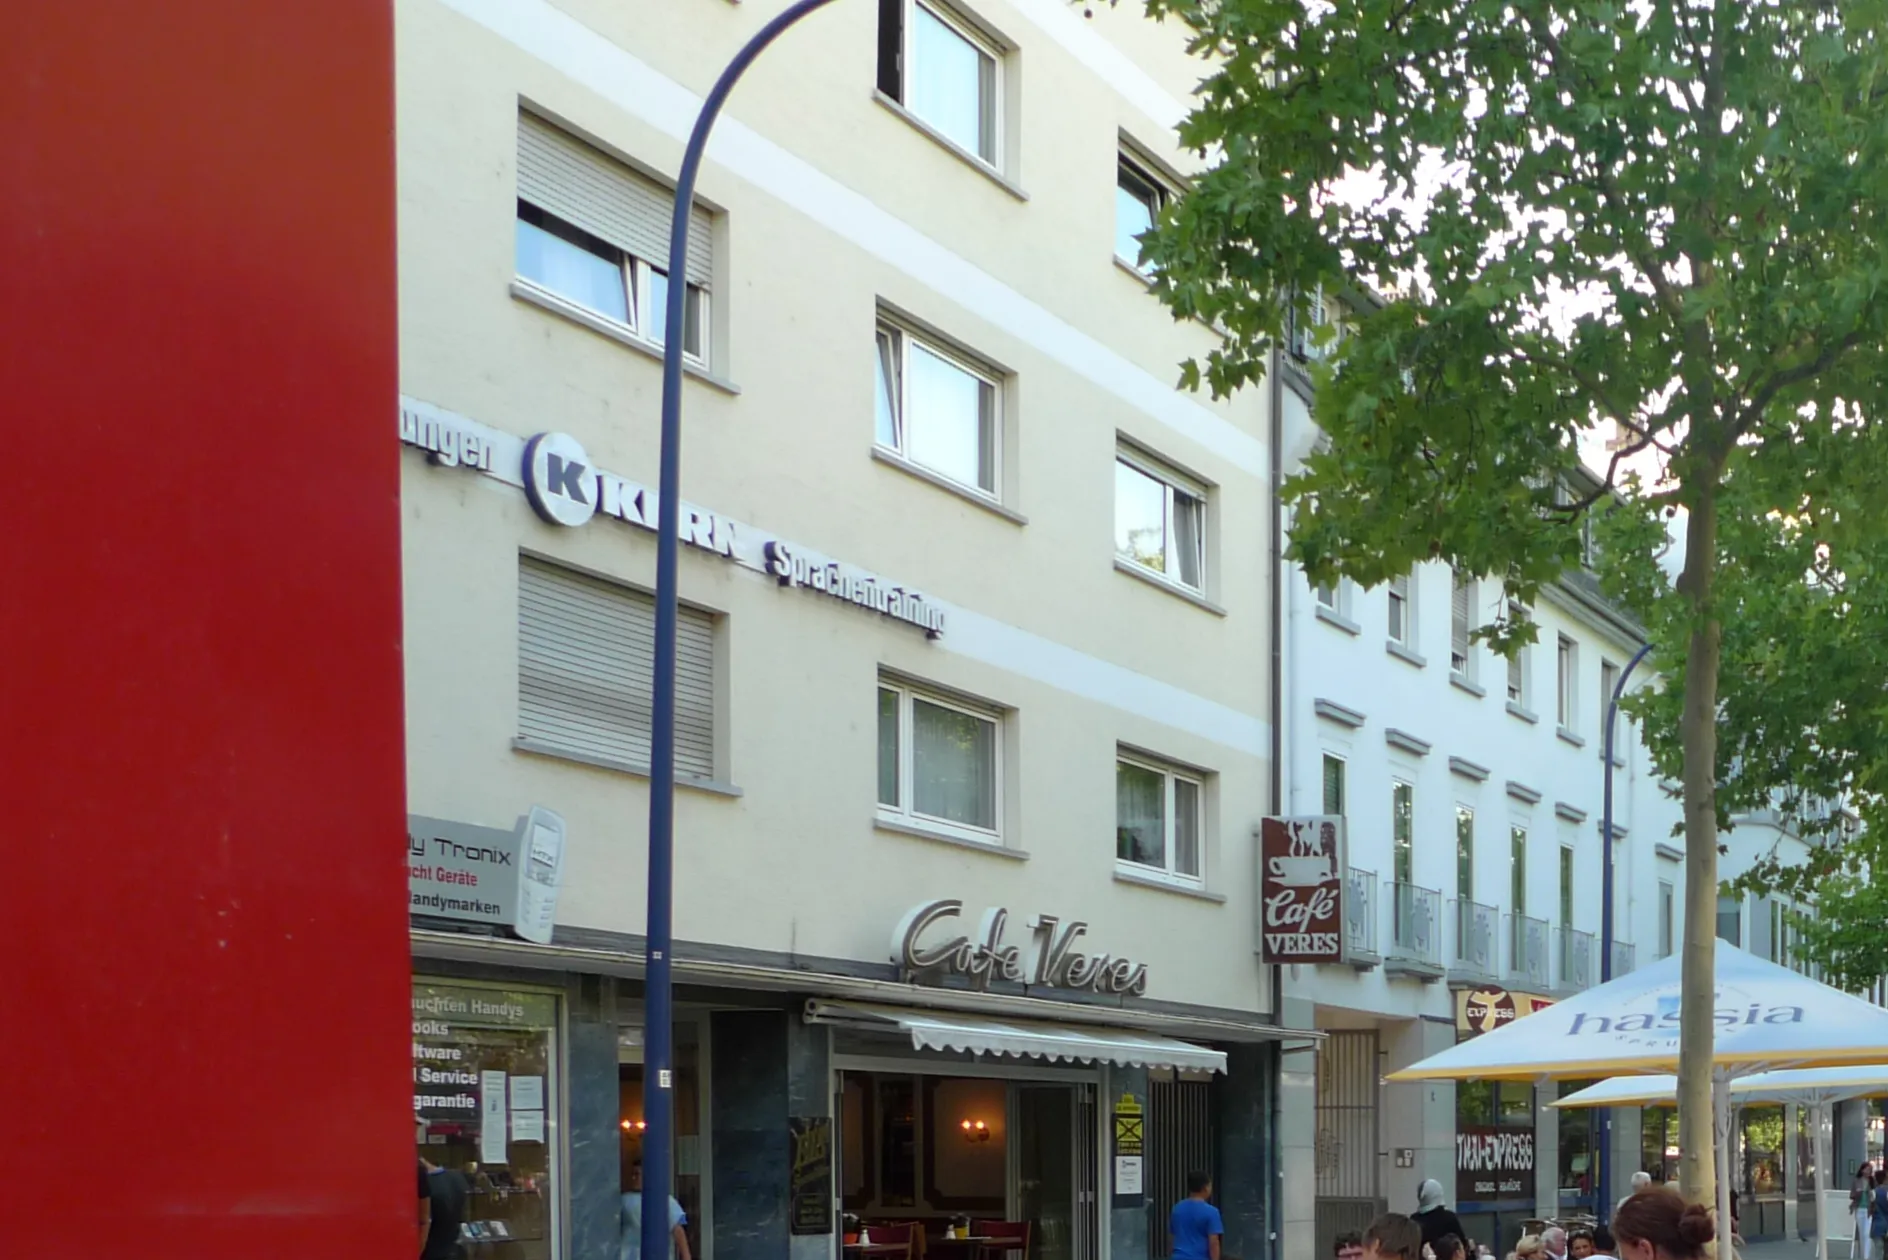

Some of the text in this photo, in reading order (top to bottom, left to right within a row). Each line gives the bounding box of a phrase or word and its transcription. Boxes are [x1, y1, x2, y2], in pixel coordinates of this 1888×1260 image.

[547, 452, 589, 504] K
[767, 541, 946, 640] Sprachentraining
[433, 838, 513, 866] Tronix
[435, 866, 478, 887] Geräte
[1264, 887, 1340, 933] Café
[1030, 914, 1149, 997] Veres
[1264, 933, 1339, 955] VERES
[471, 999, 525, 1020] Handys
[420, 1067, 479, 1085] Service
[412, 1093, 476, 1110] garantie
